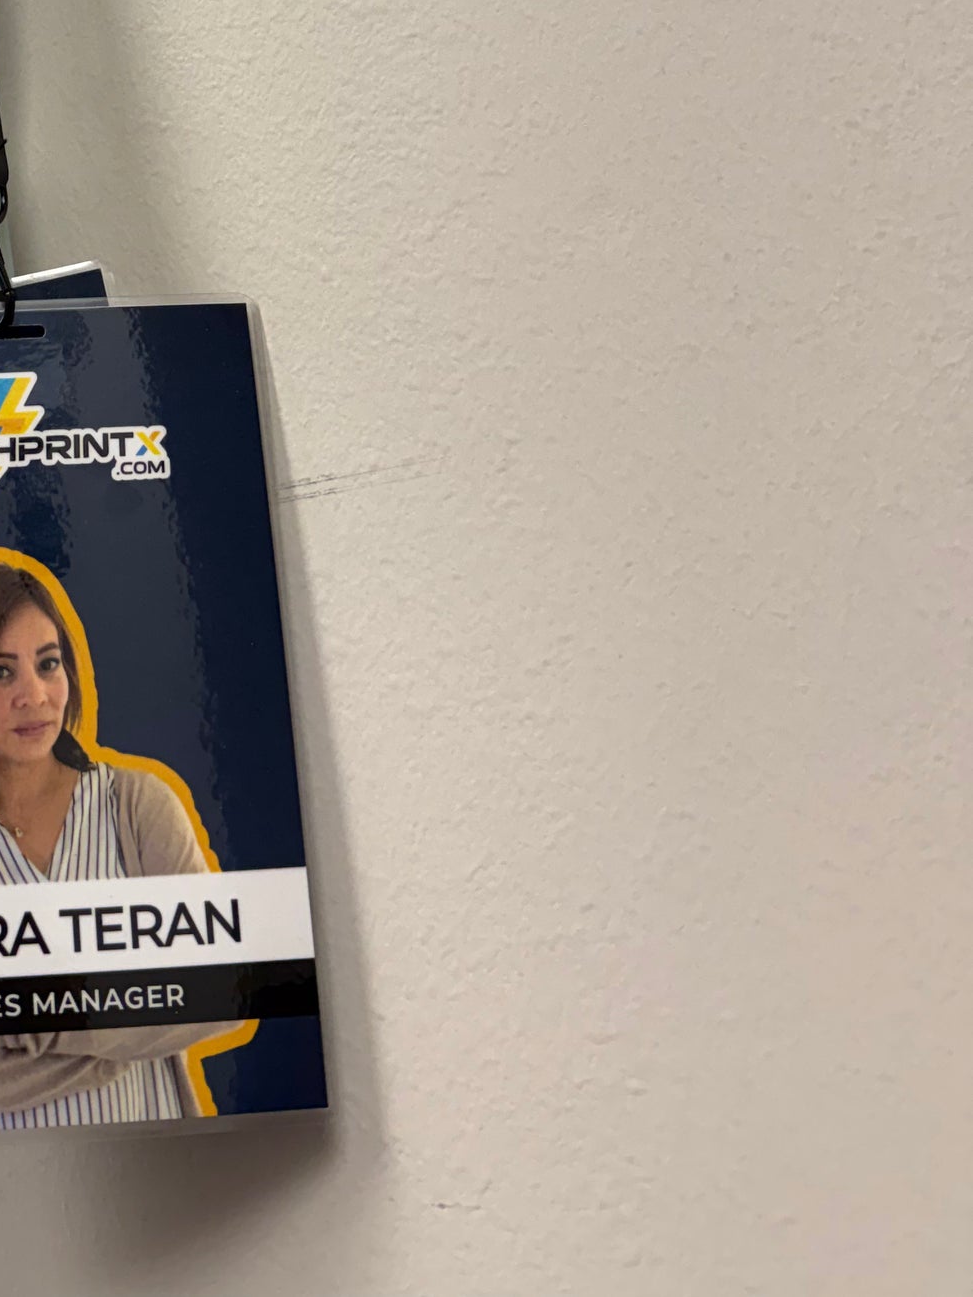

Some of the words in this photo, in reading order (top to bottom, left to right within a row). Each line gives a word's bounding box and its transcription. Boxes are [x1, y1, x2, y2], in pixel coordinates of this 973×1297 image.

[116, 459, 167, 476] .COM
[59, 898, 243, 953] TERAN
[33, 983, 186, 1016] MANAGER
